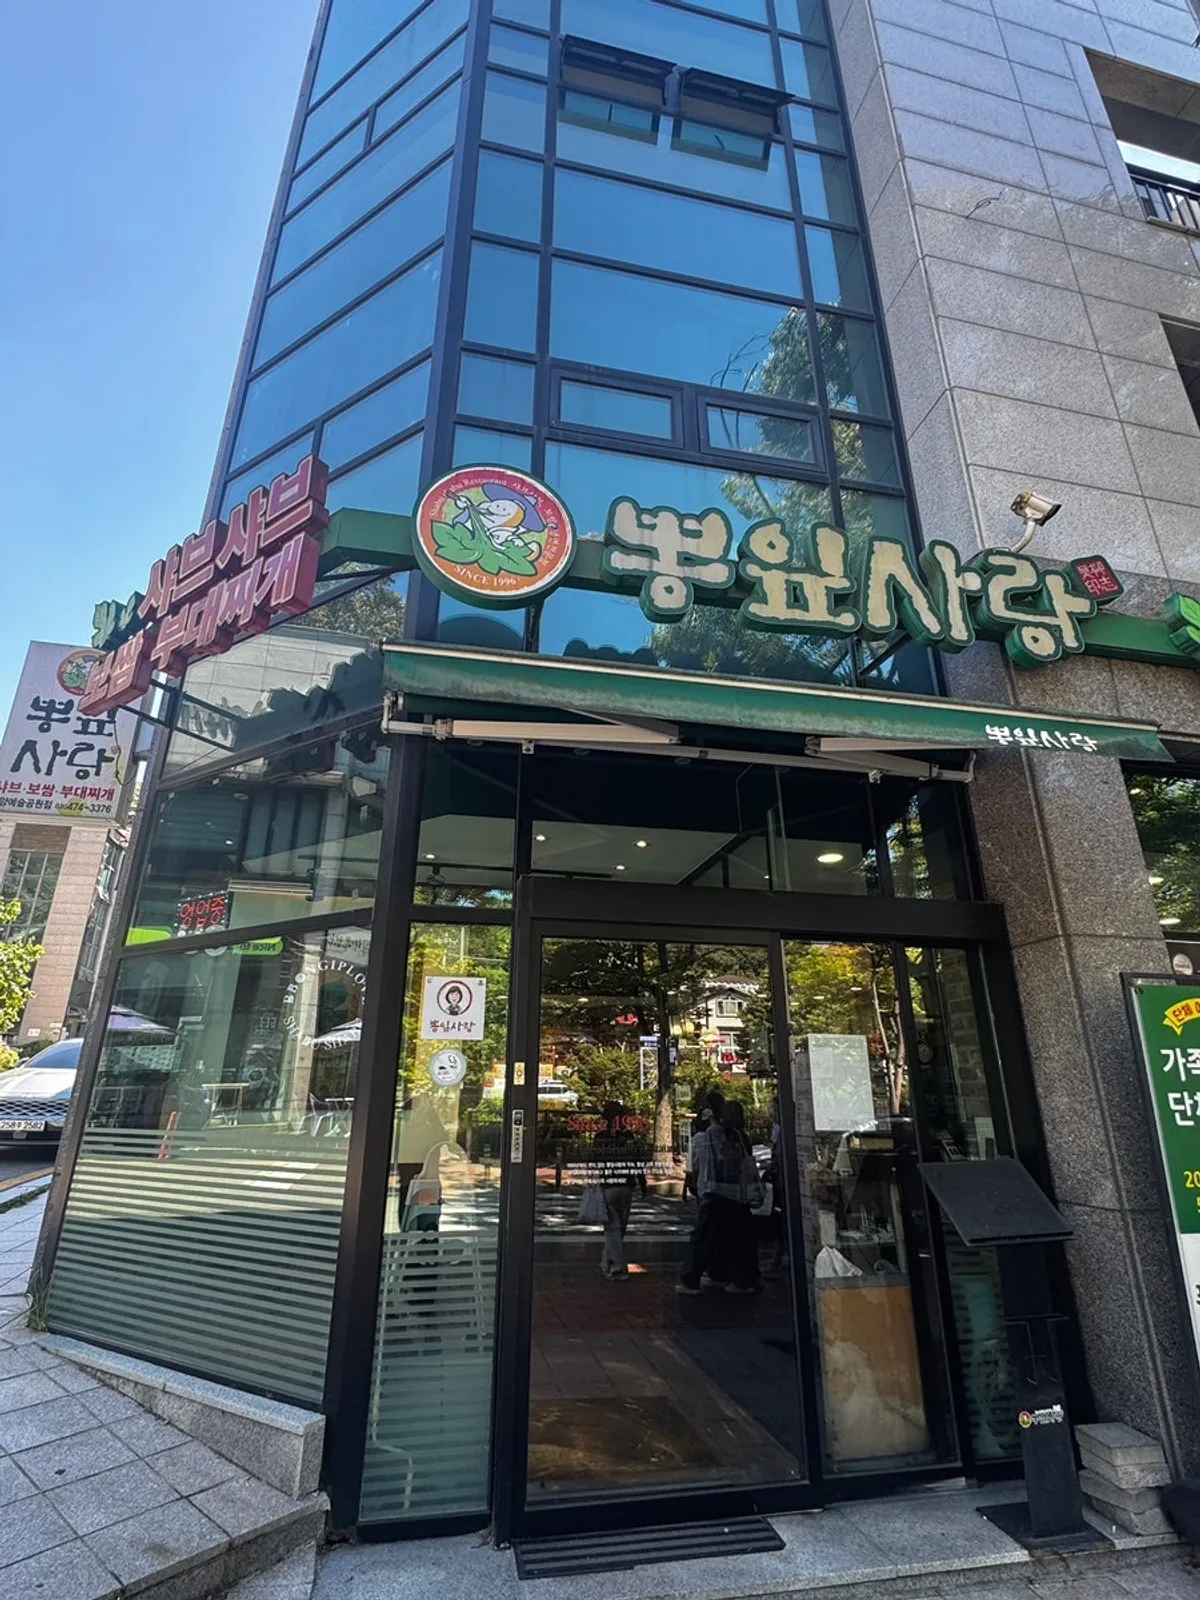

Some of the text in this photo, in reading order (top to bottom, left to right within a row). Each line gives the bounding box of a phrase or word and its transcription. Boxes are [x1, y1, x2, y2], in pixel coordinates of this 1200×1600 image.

[138, 455, 315, 620] 샤브샤브
[453, 564, 518, 587] SINCE 1996
[606, 497, 1094, 662] 뽕잎사랑
[78, 531, 308, 712] 보쌈 부대찌개
[10, 740, 115, 780] 사랑
[985, 723, 1098, 752] 뽕잎사랑
